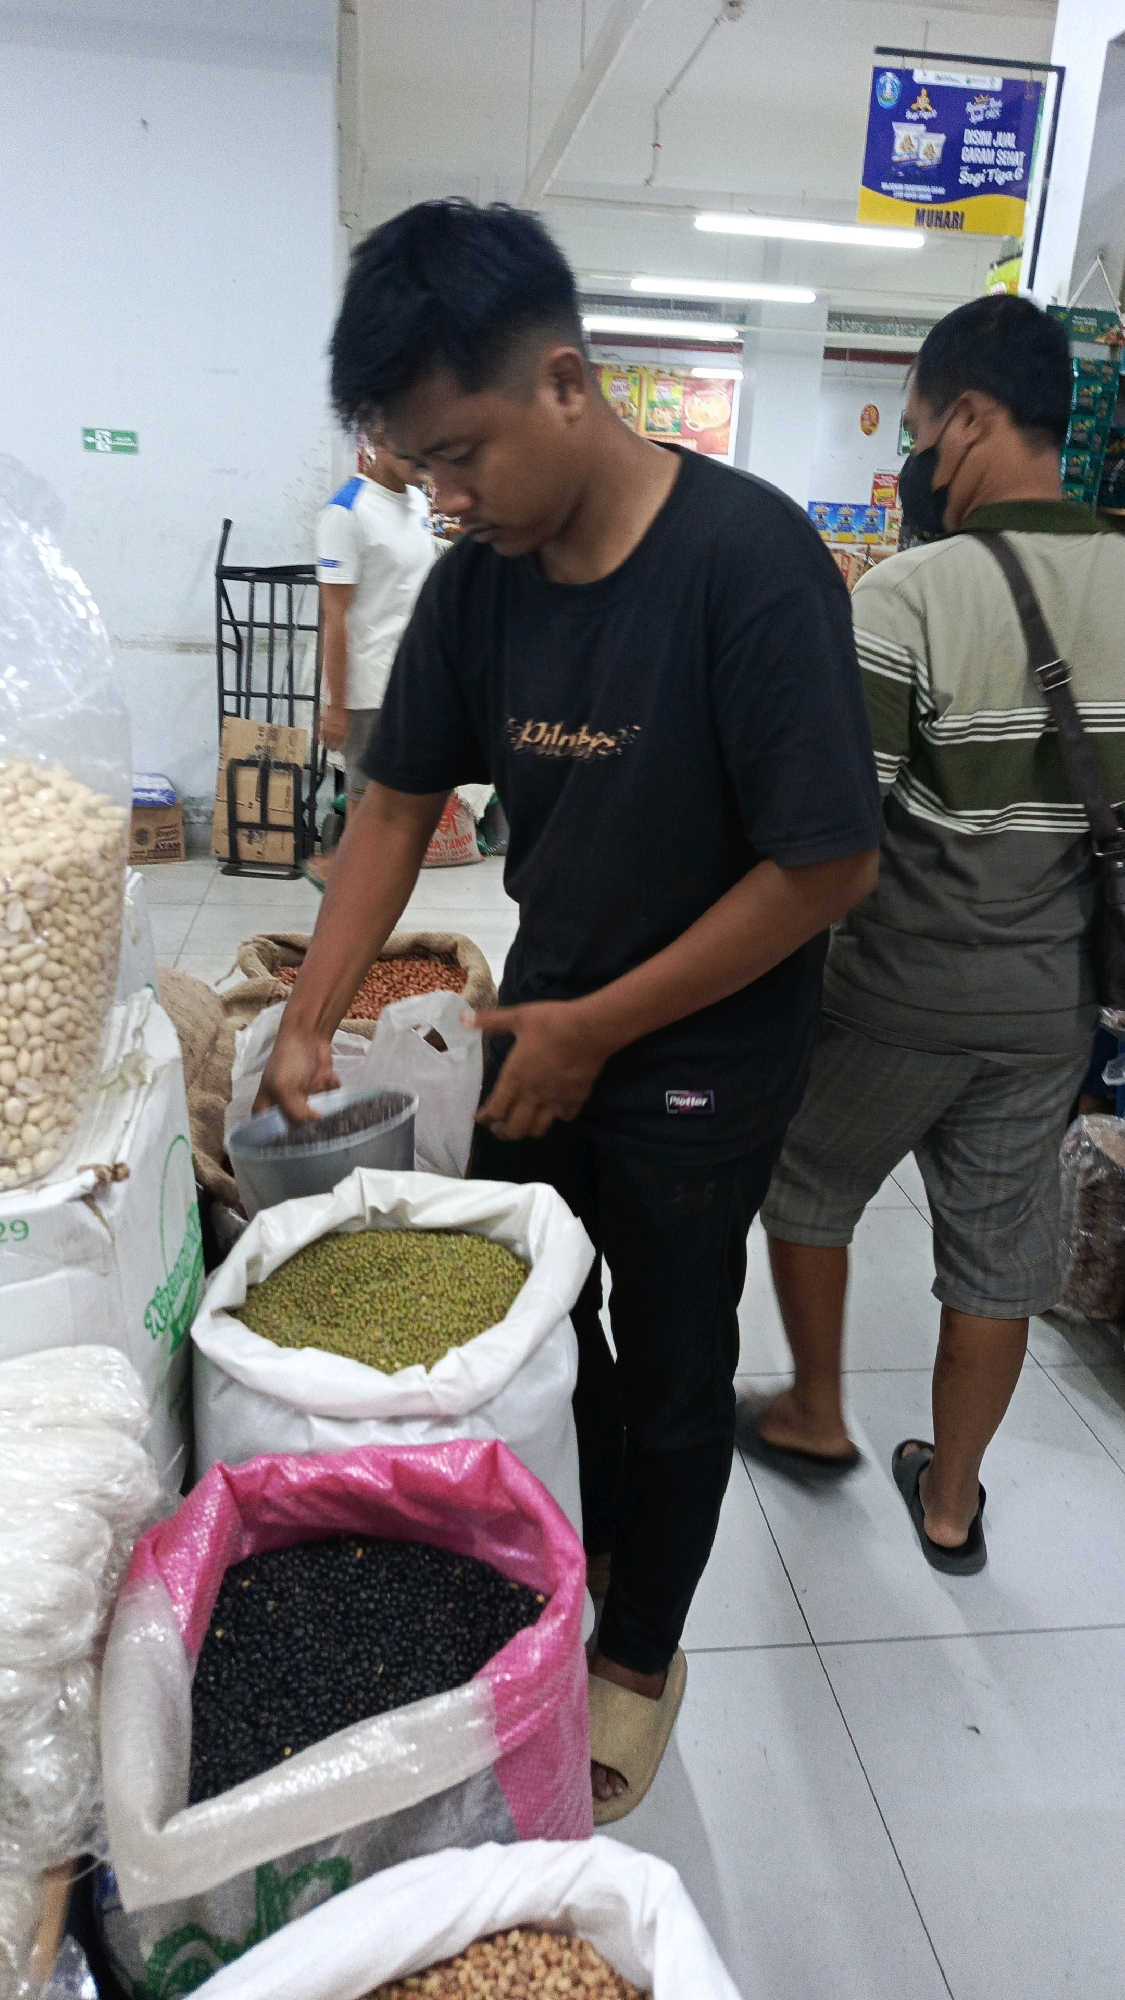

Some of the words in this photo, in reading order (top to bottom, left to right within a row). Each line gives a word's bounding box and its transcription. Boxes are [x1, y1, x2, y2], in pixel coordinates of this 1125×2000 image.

[963, 128, 993, 147] DISINI
[993, 131, 1017, 149] JUAL
[961, 146, 996, 165] GARAM
[996, 149, 1024, 167] SEHAT
[987, 168, 1014, 186] Tiga
[915, 208, 965, 230] MUHARI
[155, 842, 181, 852] AYAM
[444, 832, 473, 849] TAWON
